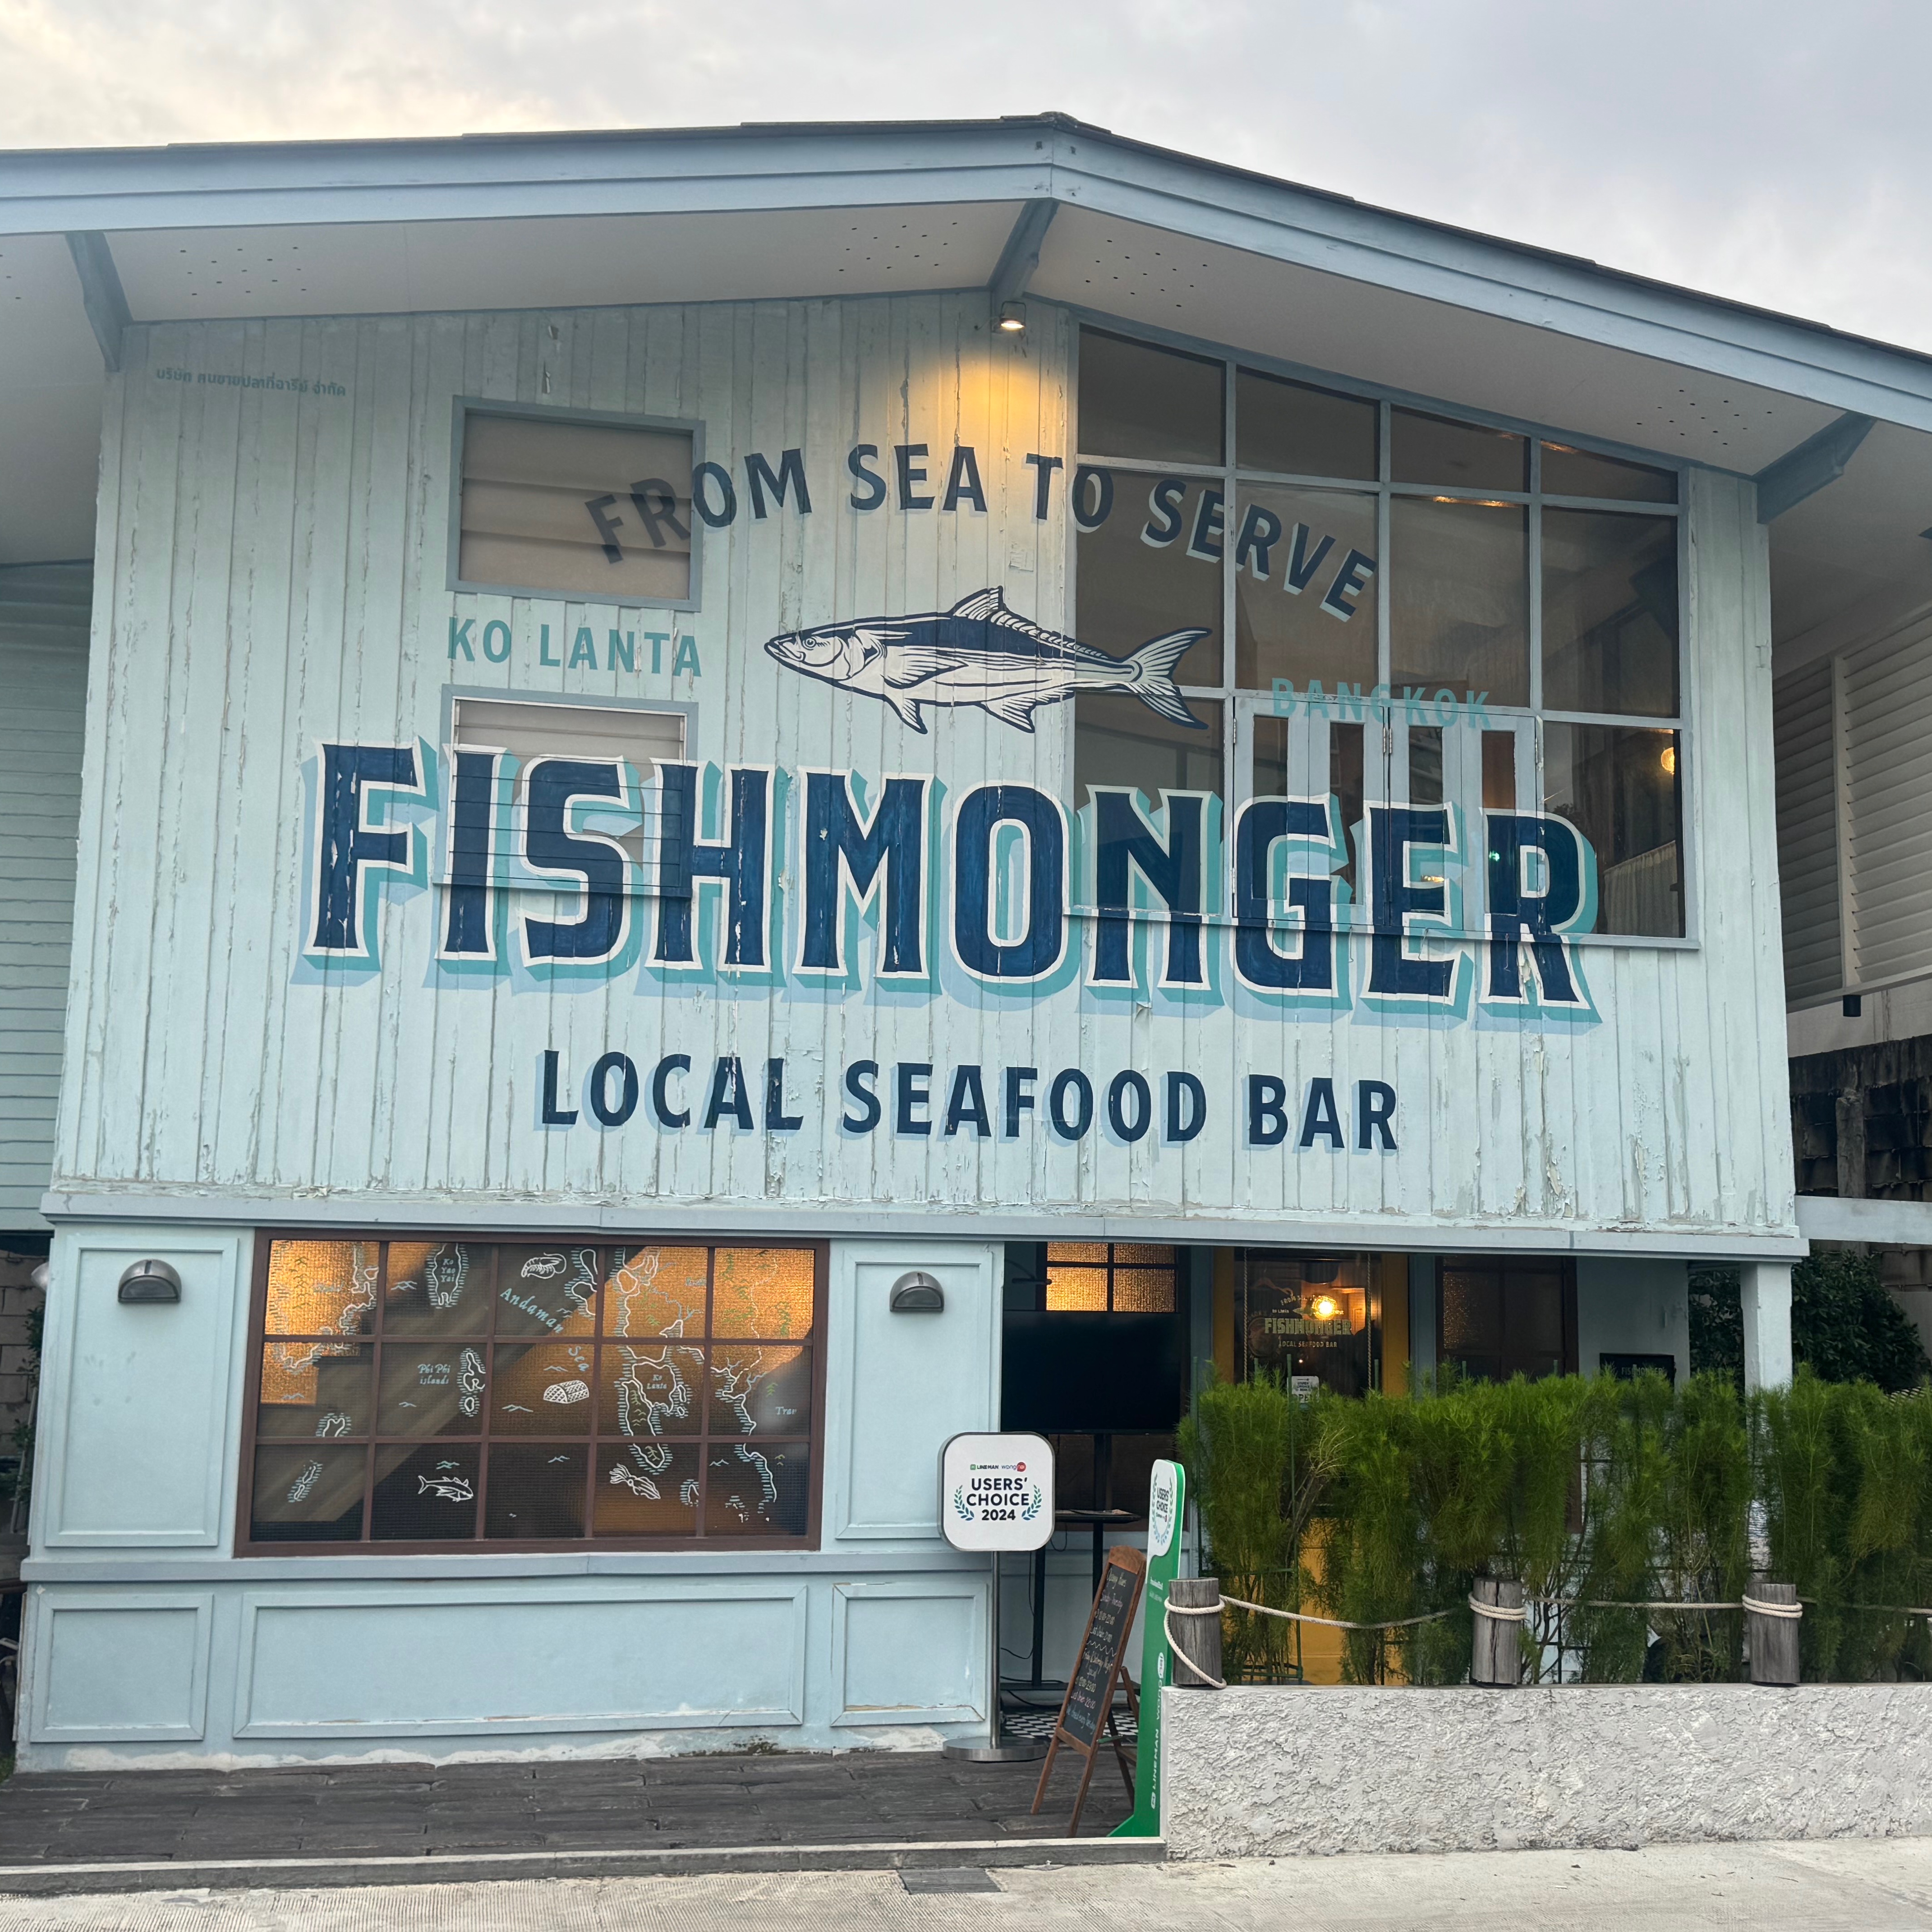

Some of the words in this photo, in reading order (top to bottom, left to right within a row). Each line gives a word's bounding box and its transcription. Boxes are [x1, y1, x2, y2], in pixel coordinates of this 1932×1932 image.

[585, 448, 812, 564] FROM
[848, 443, 988, 512] SEA
[1026, 453, 1114, 531] TO
[1141, 479, 1377, 621] SERVE
[447, 616, 512, 663] KO
[539, 624, 702, 677] LANTA
[1272, 677, 1491, 729] BANGKOK
[301, 736, 1592, 1009] FISHMONGER
[542, 1049, 805, 1130] LOCAL
[843, 1060, 1207, 1143] SEAFOOD
[1249, 1074, 1398, 1150] BAR
[499, 1288, 564, 1334] Andaman
[568, 1346, 589, 1372] Sea
[966, 1493, 1029, 1506] CHOICE
[971, 1477, 1028, 1491] USERS'
[981, 1509, 1016, 1521] 2024
